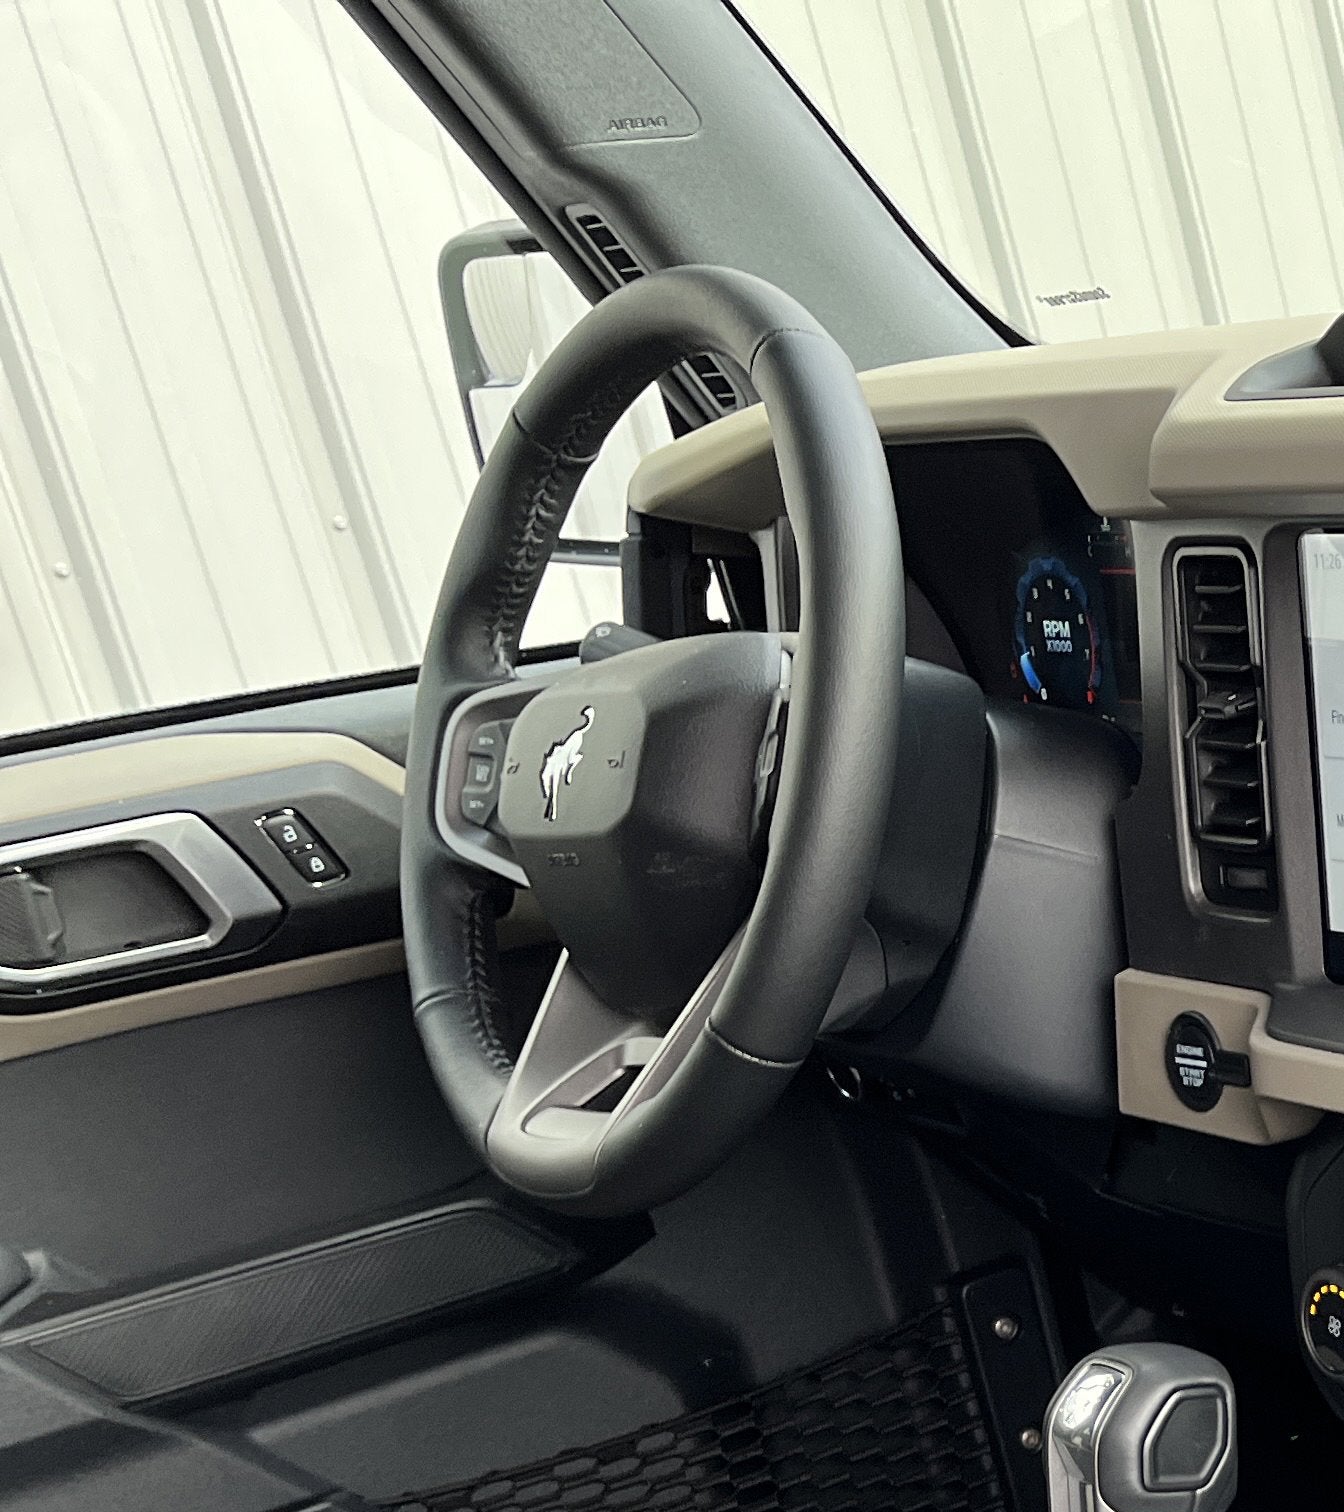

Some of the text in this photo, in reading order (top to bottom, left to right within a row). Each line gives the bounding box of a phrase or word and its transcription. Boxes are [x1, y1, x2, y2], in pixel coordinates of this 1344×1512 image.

[607, 115, 669, 132] AIRBAG
[1313, 553, 1342, 570] 11:26
[1043, 620, 1071, 638] RPM
